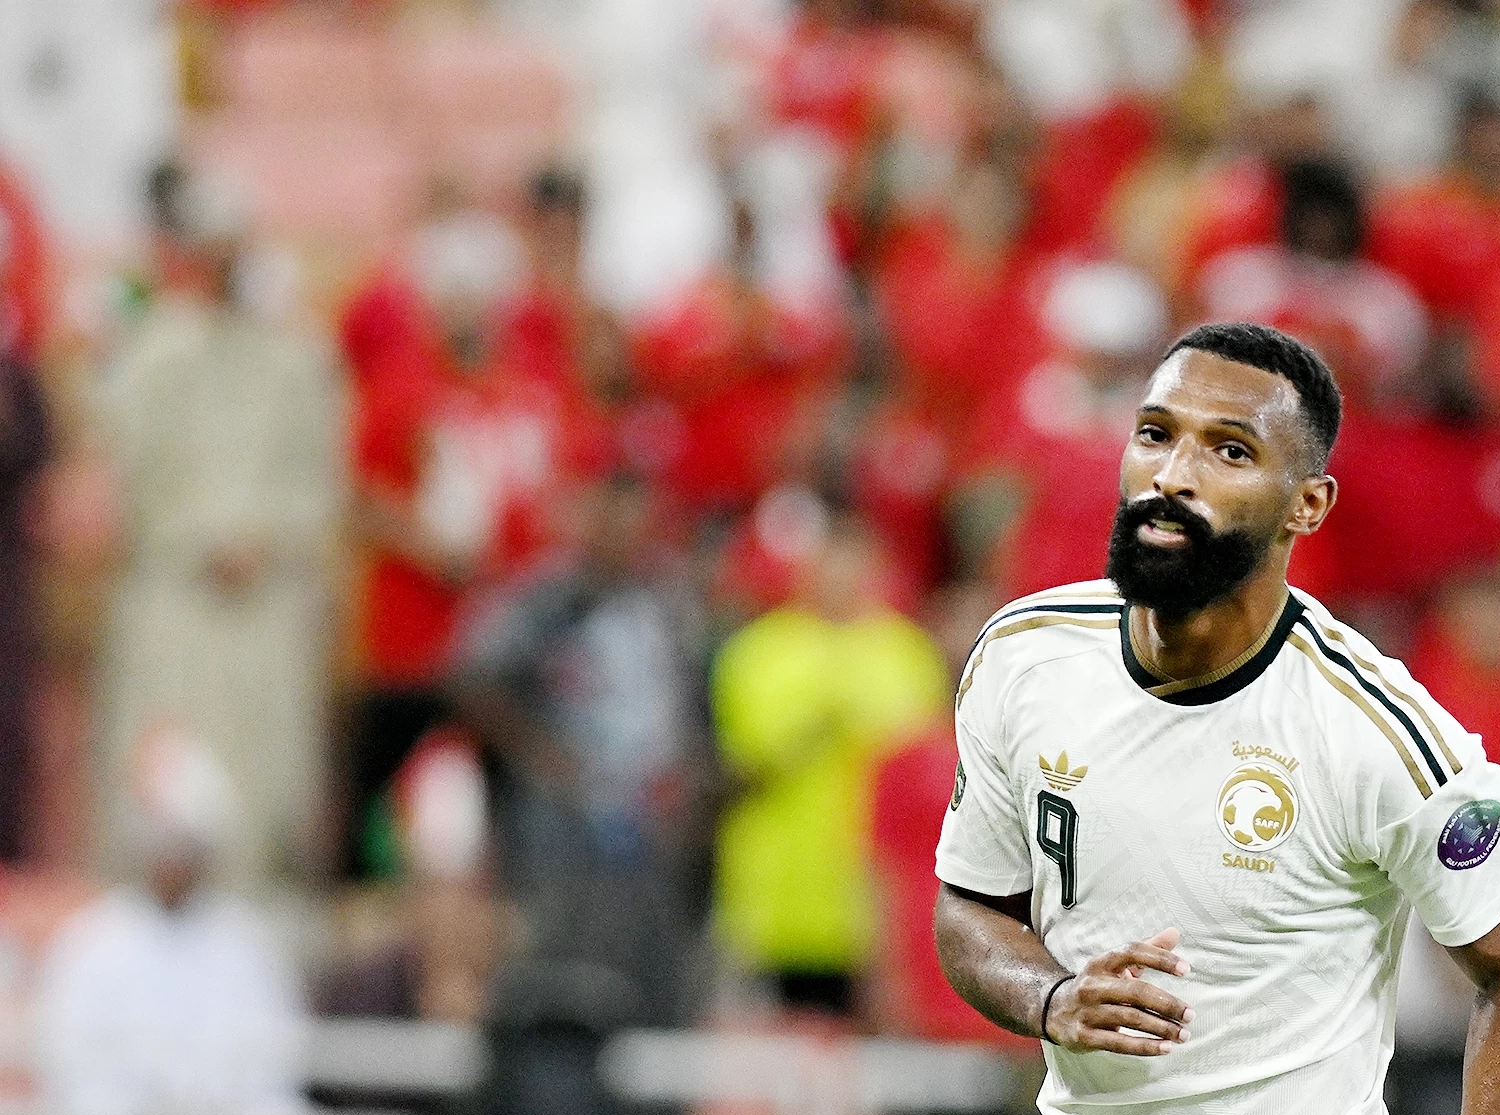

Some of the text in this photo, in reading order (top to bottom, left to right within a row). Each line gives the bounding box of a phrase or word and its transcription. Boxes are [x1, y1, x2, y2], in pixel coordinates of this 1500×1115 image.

[1232, 740, 1299, 773] السعودية
[1254, 817, 1280, 830] SAFF
[1037, 789, 1079, 910] 9
[1457, 851, 1488, 867] FOOTBALL
[1222, 853, 1275, 873] SAUDI
